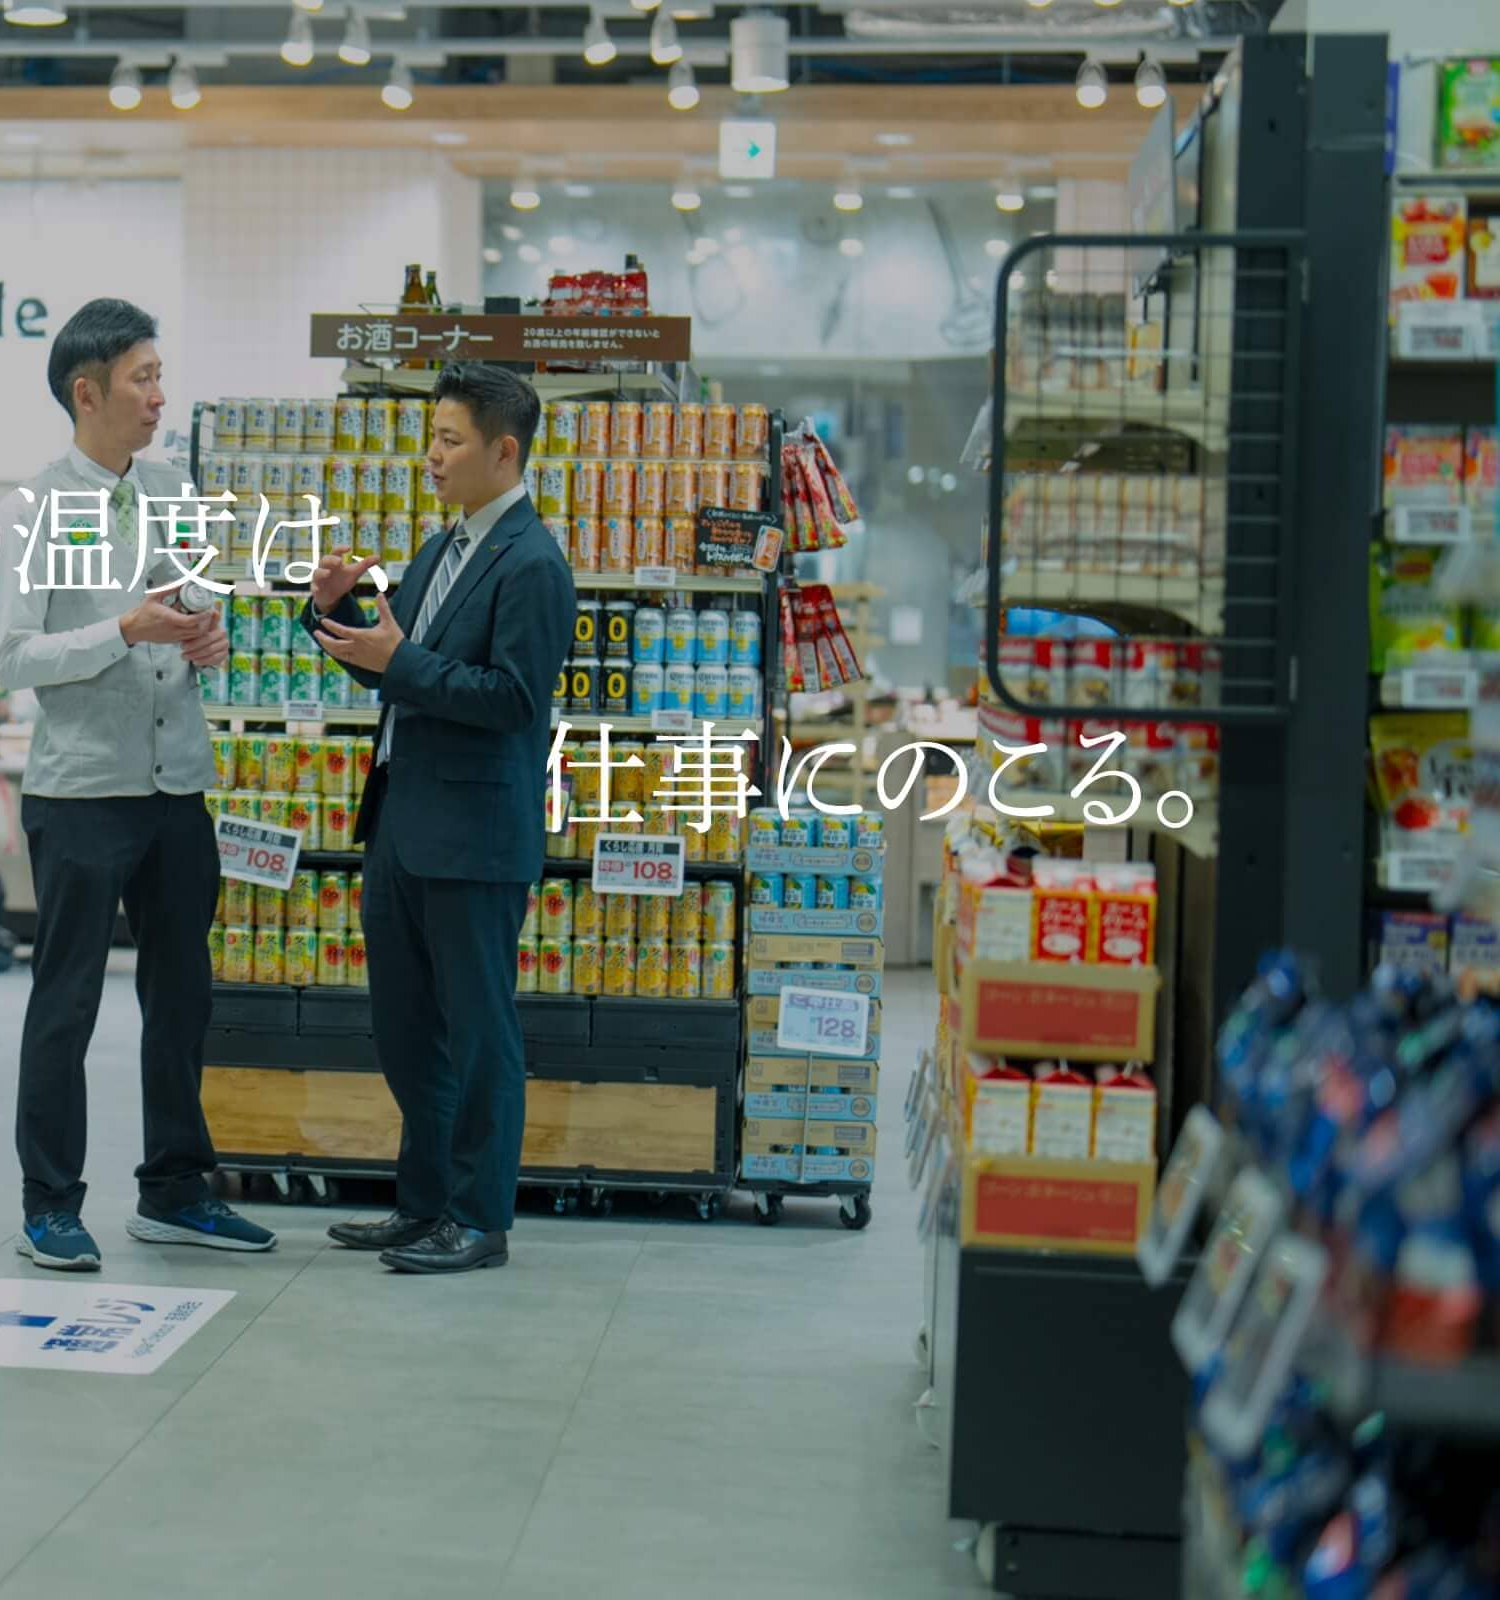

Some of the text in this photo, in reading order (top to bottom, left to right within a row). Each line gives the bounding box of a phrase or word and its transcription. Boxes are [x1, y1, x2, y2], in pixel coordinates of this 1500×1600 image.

[336, 322, 494, 351] お酒コーナー
[575, 615, 594, 642] 0
[609, 616, 628, 642] 0
[572, 672, 591, 698] 0
[607, 672, 627, 699] 0
[246, 847, 286, 872] 108
[632, 861, 673, 880] 108
[816, 1016, 855, 1038] 128
